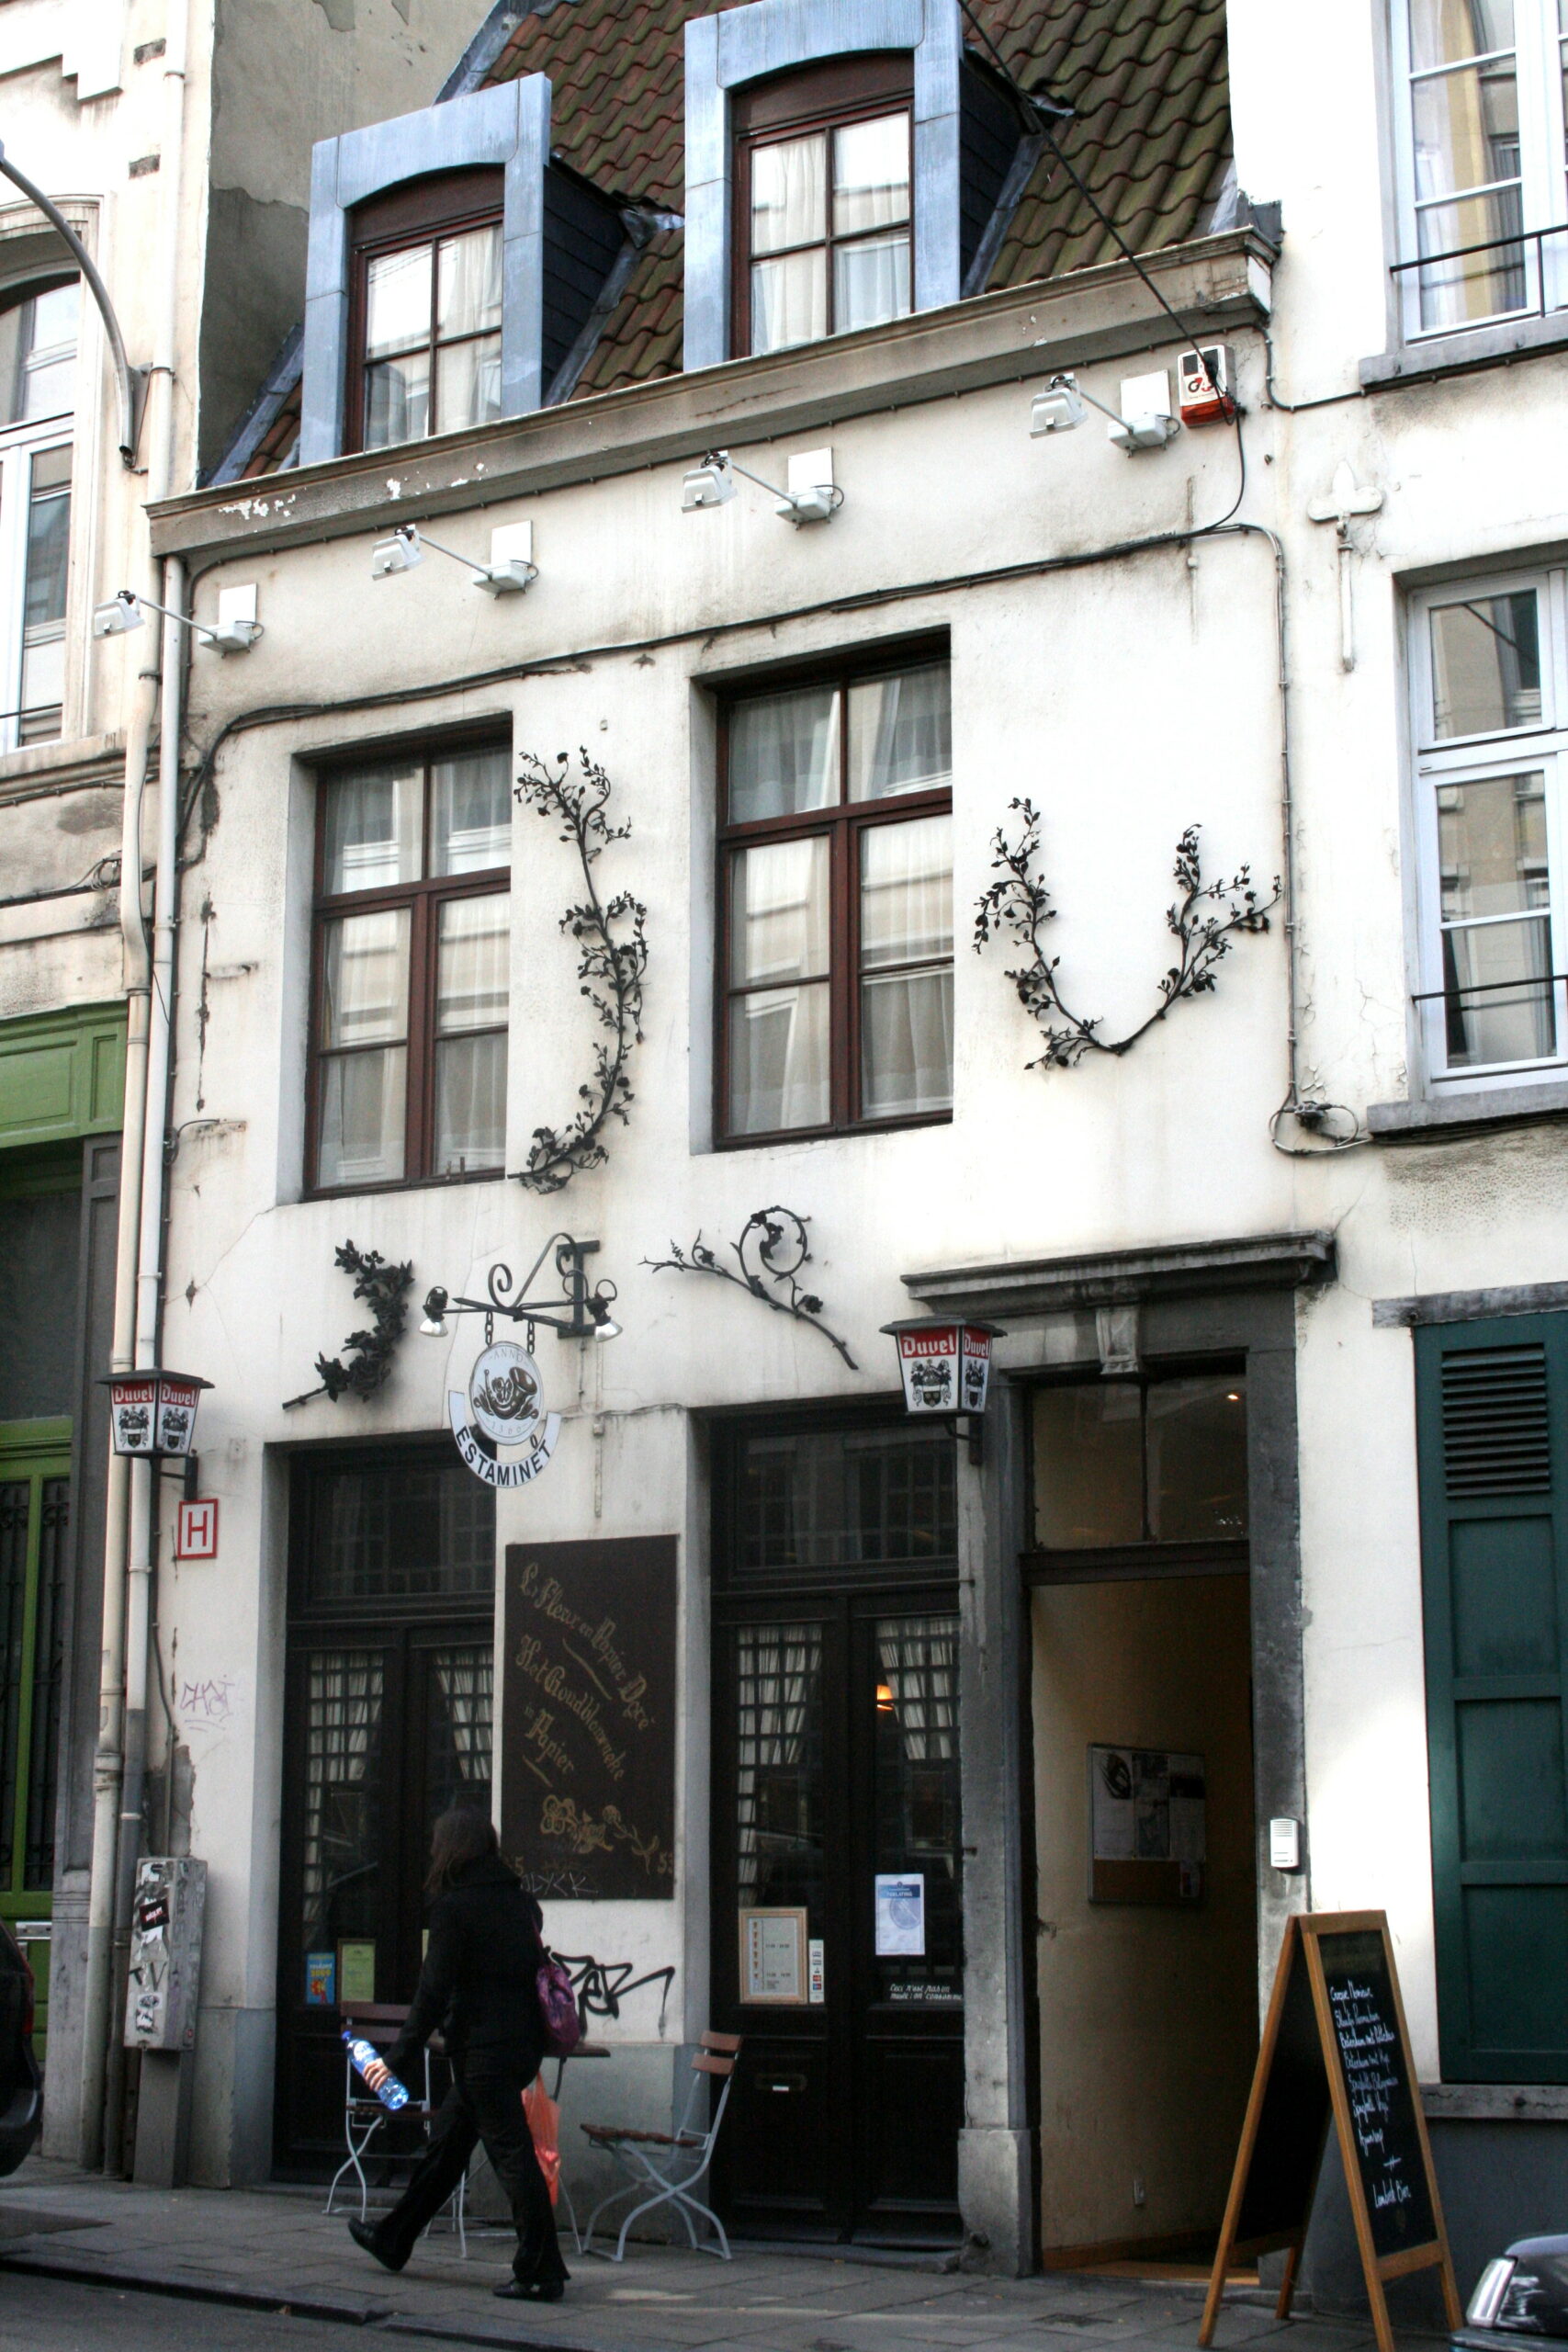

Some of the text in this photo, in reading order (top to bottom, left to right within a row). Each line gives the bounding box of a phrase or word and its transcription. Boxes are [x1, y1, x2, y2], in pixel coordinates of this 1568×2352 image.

[903, 1334, 954, 1355] Duvel
[964, 1332, 989, 1356] Duvel
[114, 1384, 153, 1403] Duvel
[162, 1384, 196, 1406] Duvel
[456, 1426, 551, 1486] ESTAMINET
[187, 1510, 208, 1547] H
[535, 1577, 581, 1629] Fleur
[579, 1622, 595, 1638] en
[591, 1616, 627, 1680] Papier
[525, 1708, 575, 1775] Papier
